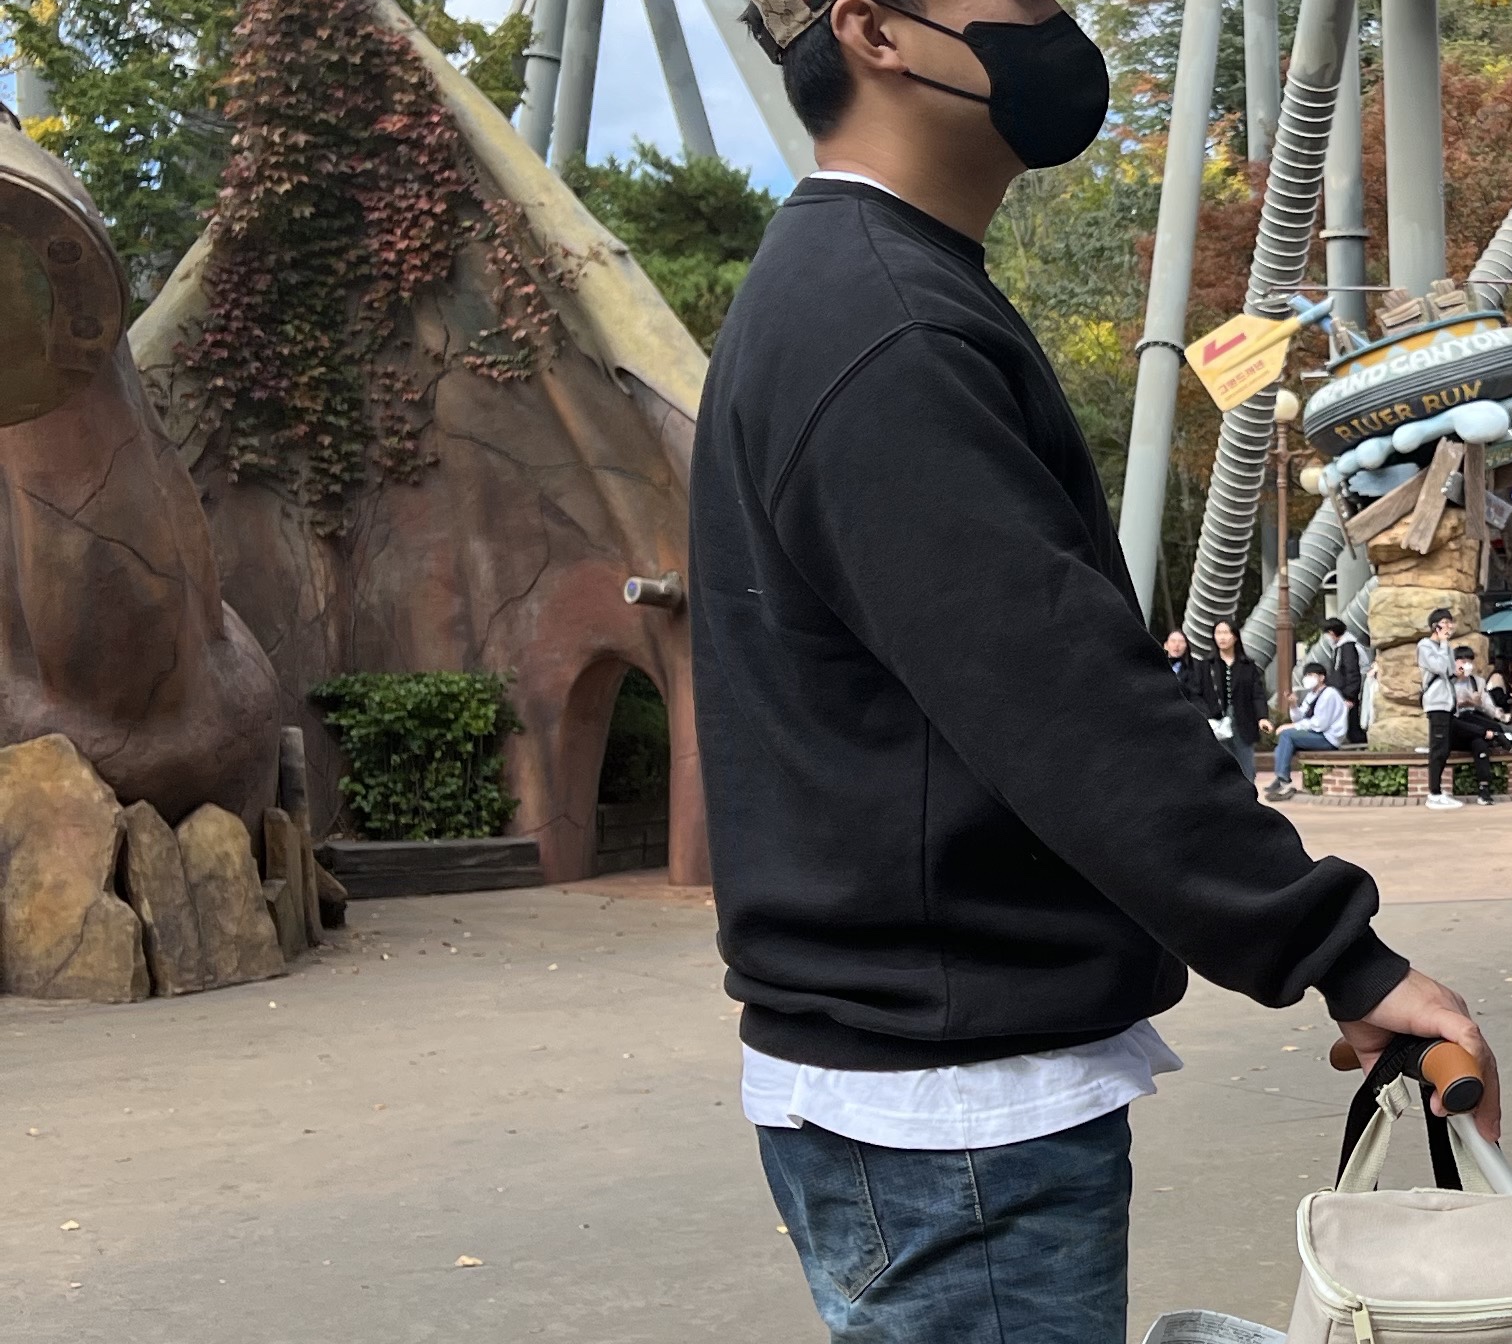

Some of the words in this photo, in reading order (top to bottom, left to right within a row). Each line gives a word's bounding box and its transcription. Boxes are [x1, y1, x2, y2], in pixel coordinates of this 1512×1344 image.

[1390, 328, 1512, 375] CANYON
[1333, 402, 1417, 444] RIVER
[1420, 378, 1483, 414] RUN
